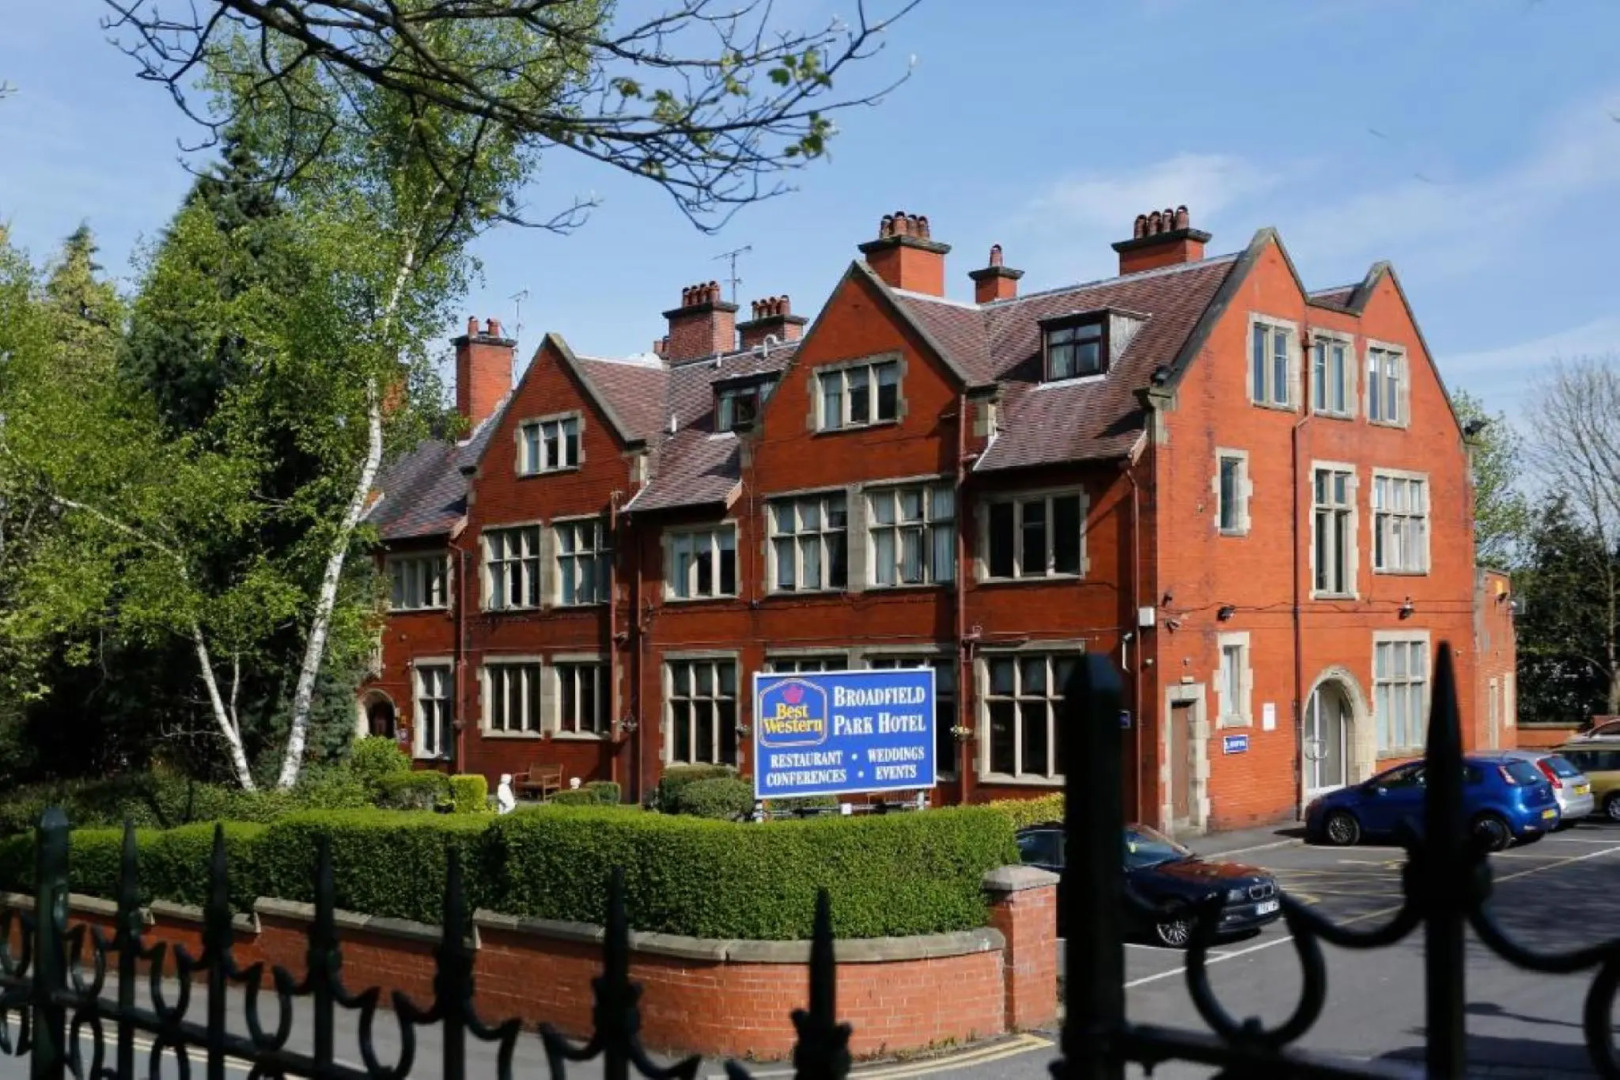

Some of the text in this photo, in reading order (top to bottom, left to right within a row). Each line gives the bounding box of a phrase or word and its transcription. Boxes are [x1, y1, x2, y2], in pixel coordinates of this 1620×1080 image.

[834, 686, 925, 706] BROADFIELD
[777, 704, 808, 718] Best
[764, 718, 821, 734] Western
[834, 712, 926, 735] PARK HOTEL
[771, 747, 924, 767] RESTAURANT WEDDINGS
[767, 765, 916, 786] CONFERENCES EVENTS
